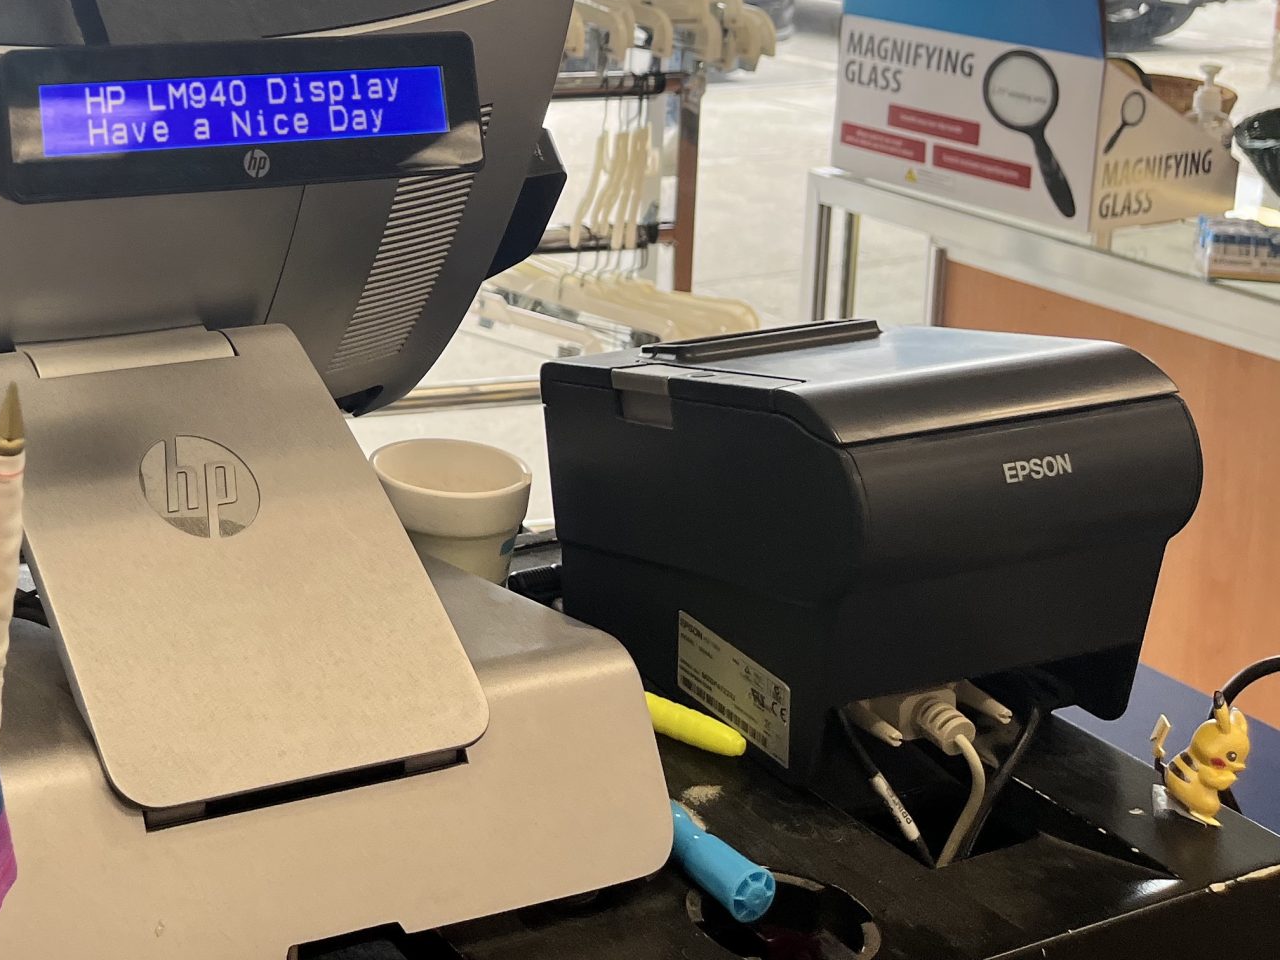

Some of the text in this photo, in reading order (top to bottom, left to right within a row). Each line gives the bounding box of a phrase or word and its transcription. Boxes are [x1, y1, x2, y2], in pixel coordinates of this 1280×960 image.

[846, 32, 975, 77] MAGNIFYING
[85, 74, 399, 114] HP LM940 Display
[845, 60, 903, 93] GLASS
[88, 105, 383, 146] Have a Nice Day
[246, 149, 268, 178] hp
[1102, 150, 1213, 187] MAGNIFYING
[1099, 190, 1152, 219] GLASS
[1003, 453, 1072, 483] EPSON
[165, 437, 238, 538] hp
